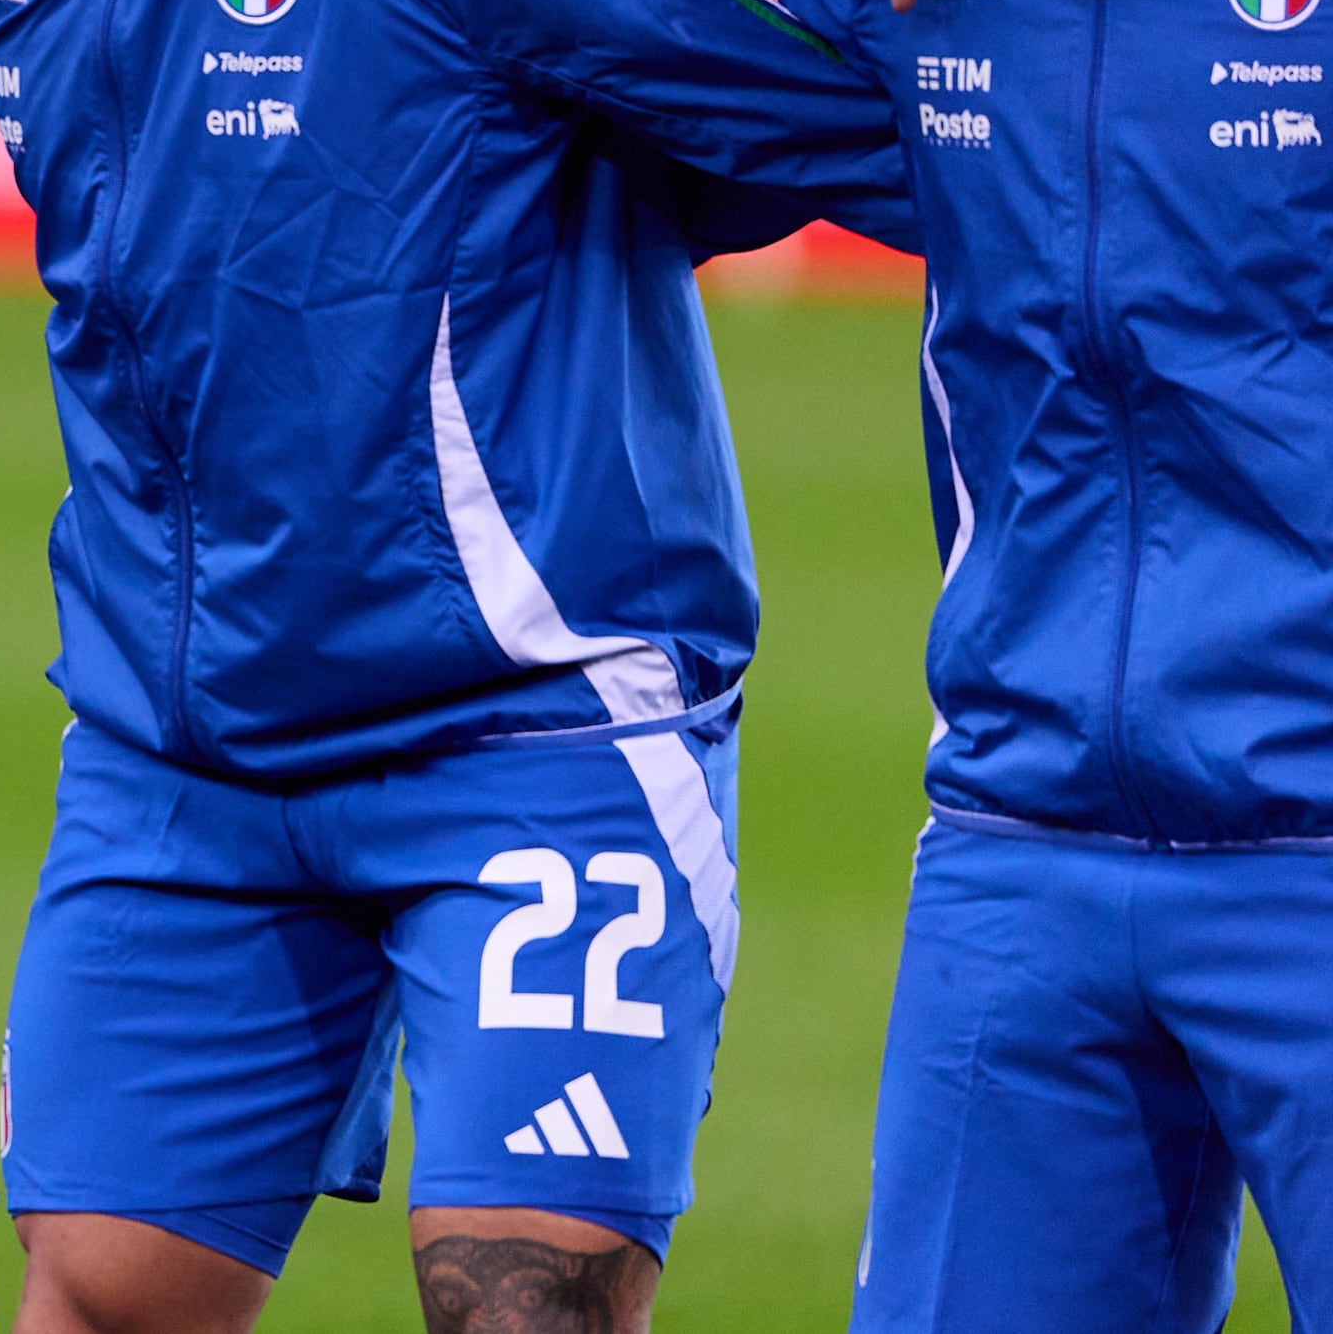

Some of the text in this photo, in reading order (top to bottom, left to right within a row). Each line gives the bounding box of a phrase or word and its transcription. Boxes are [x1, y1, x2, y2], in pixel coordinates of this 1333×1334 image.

[219, 52, 303, 76] Telepass
[941, 58, 992, 93] TIM
[1230, 62, 1323, 87] Telepass
[206, 102, 256, 136] eni
[919, 103, 991, 140] Poste
[1209, 112, 1269, 148] eni
[477, 847, 666, 1038] 22
